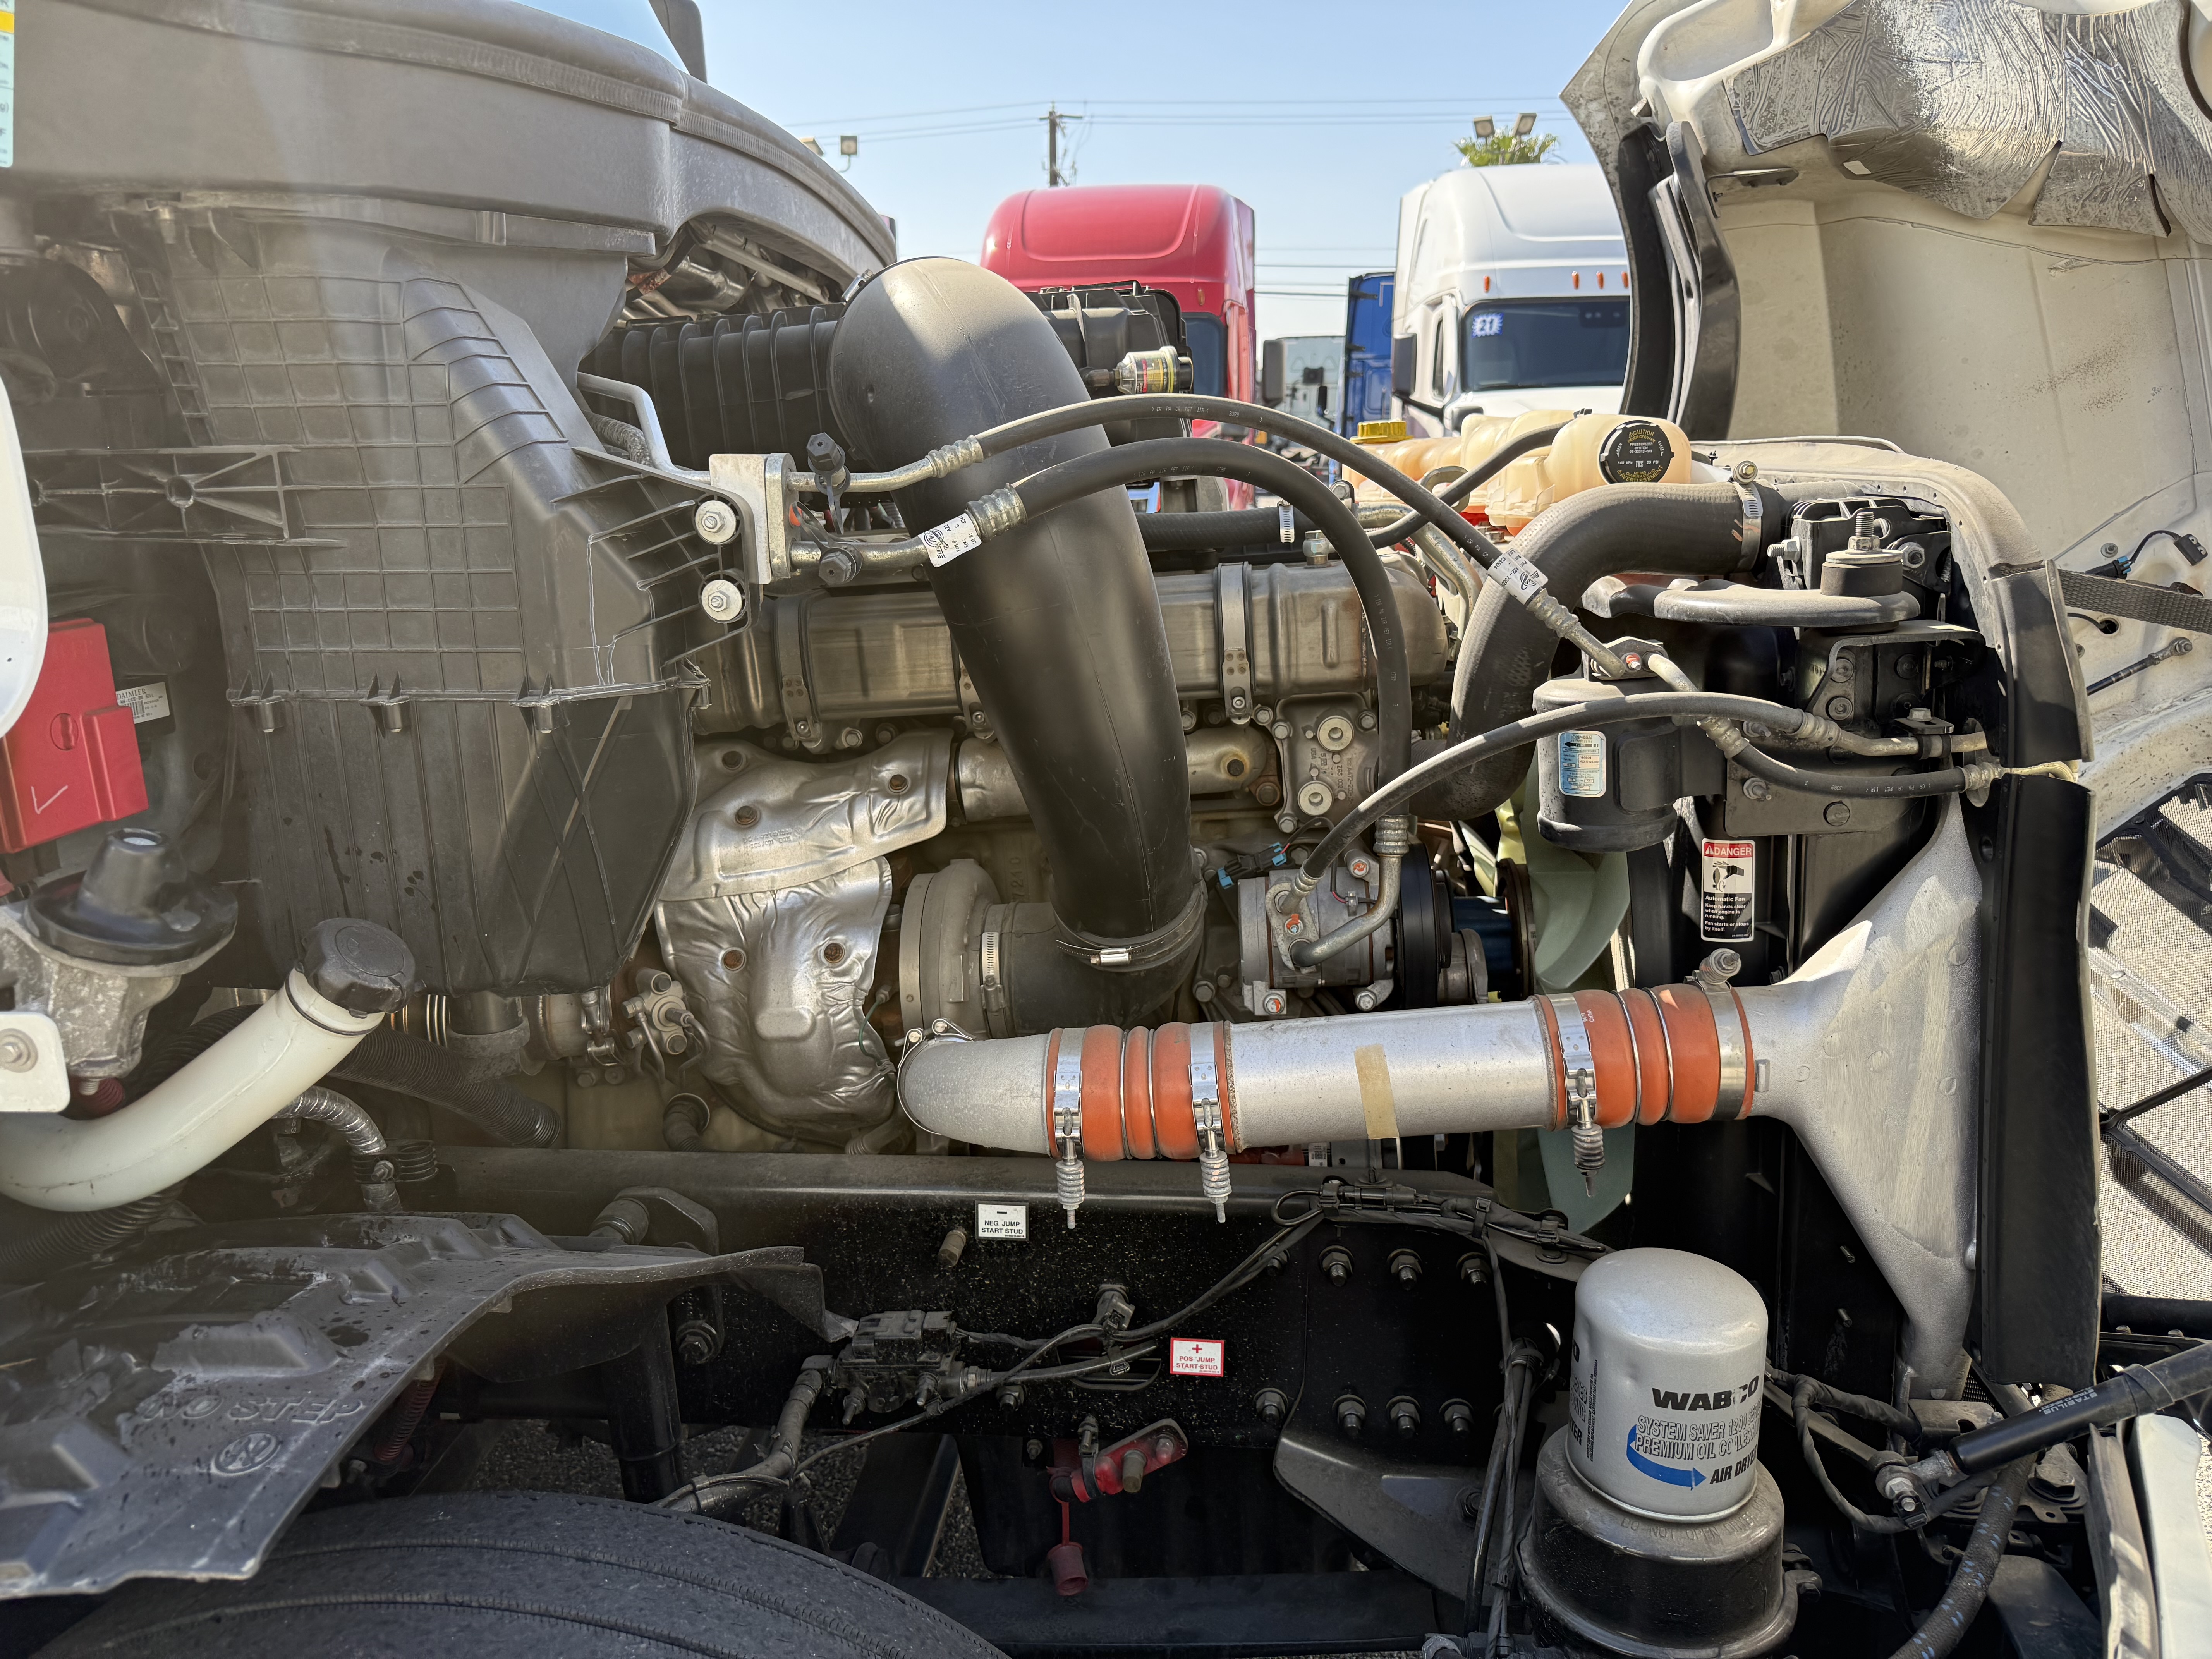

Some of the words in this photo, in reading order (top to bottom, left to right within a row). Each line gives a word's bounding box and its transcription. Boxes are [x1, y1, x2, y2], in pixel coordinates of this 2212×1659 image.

[1620, 465, 1663, 483] AVERTISSEMENT
[117, 688, 146, 700] DAIMLER
[1714, 847, 1752, 856] DANGER
[1586, 1009, 1595, 1022] CHINA
[142, 1395, 223, 1419] NO
[228, 1396, 366, 1424] STEP
[2043, 1392, 2098, 1414] STABILUS
[1637, 1415, 1687, 1441] SYSTEM
[1689, 1421, 1725, 1441] SAVER
[1728, 1413, 1747, 1436] 1200
[1635, 1436, 1695, 1460] PREMIUM
[1697, 1442, 1716, 1460] OIL
[1709, 1465, 1733, 1484] AIR
[1620, 1517, 1640, 1531] DO
[1649, 1525, 1674, 1539] NOT
[1686, 1526, 1721, 1540] OPEN
